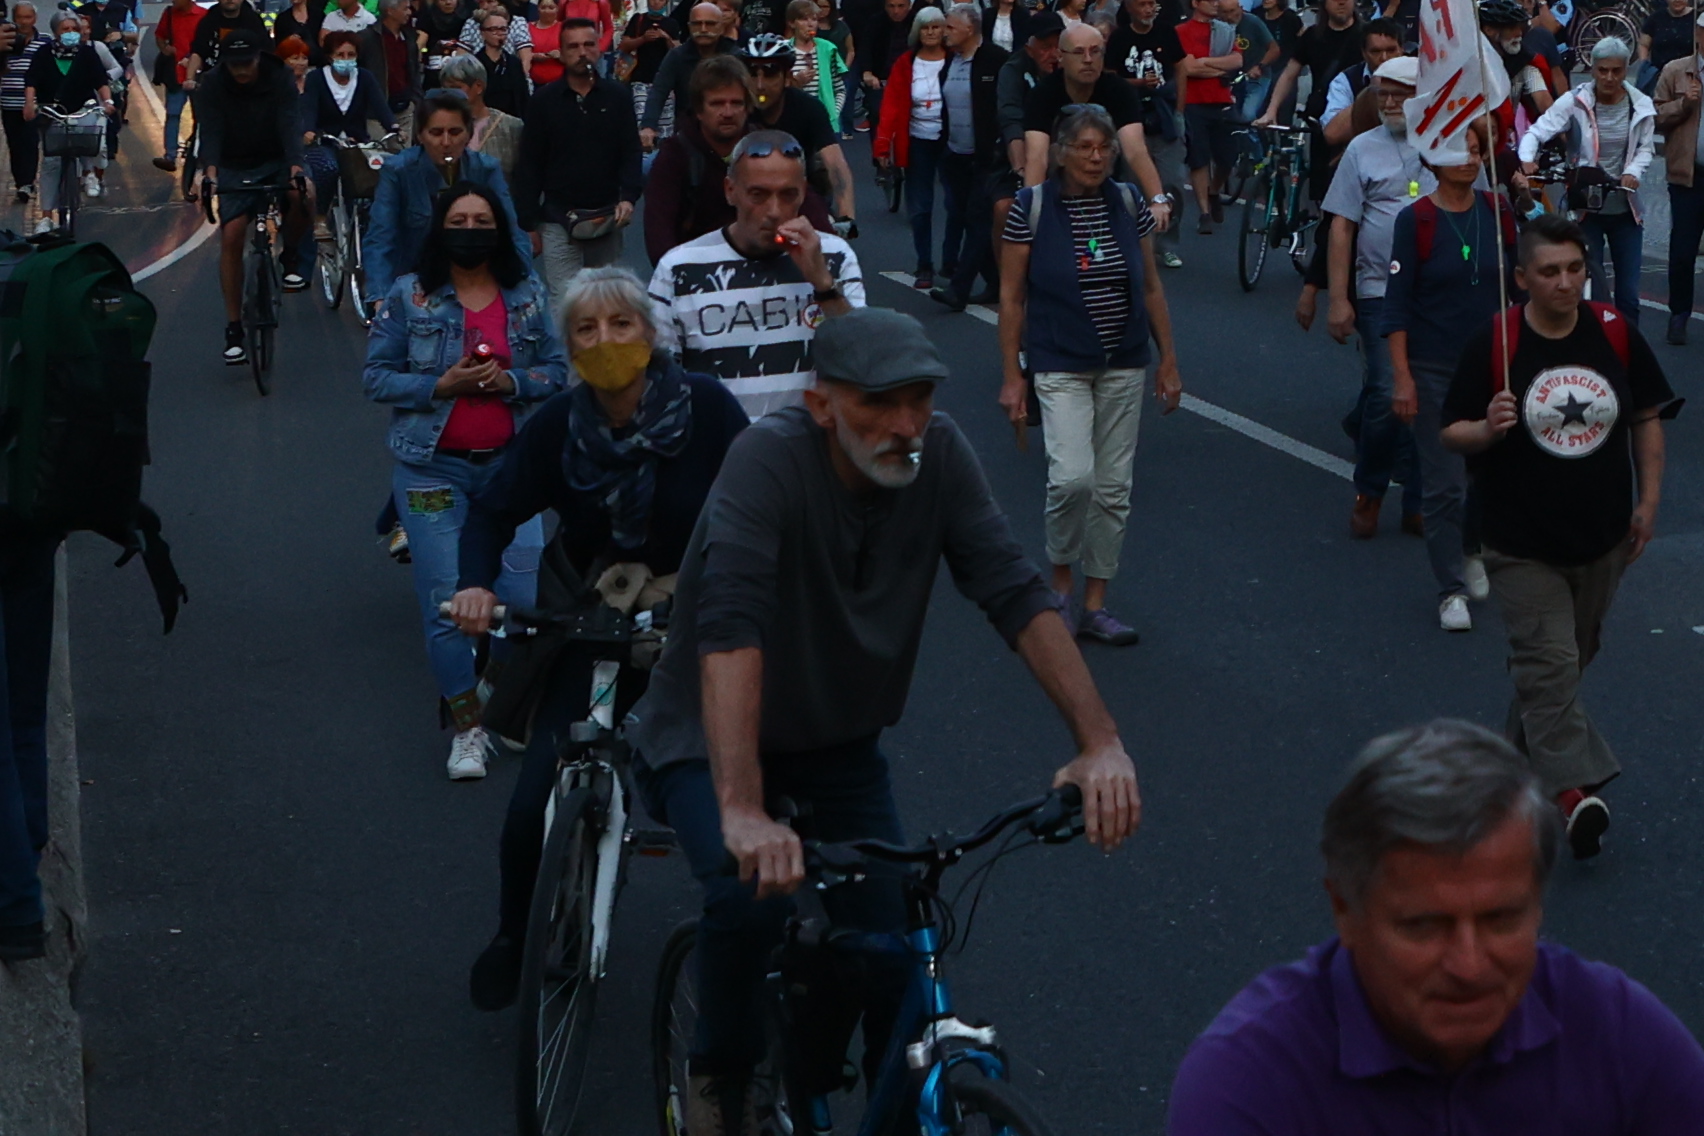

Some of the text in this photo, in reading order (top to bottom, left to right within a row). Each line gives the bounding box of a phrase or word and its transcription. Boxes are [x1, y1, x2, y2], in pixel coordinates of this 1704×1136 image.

[1536, 375, 1607, 404] ANTIFASCIST
[1541, 421, 1605, 447] ALL STARS
